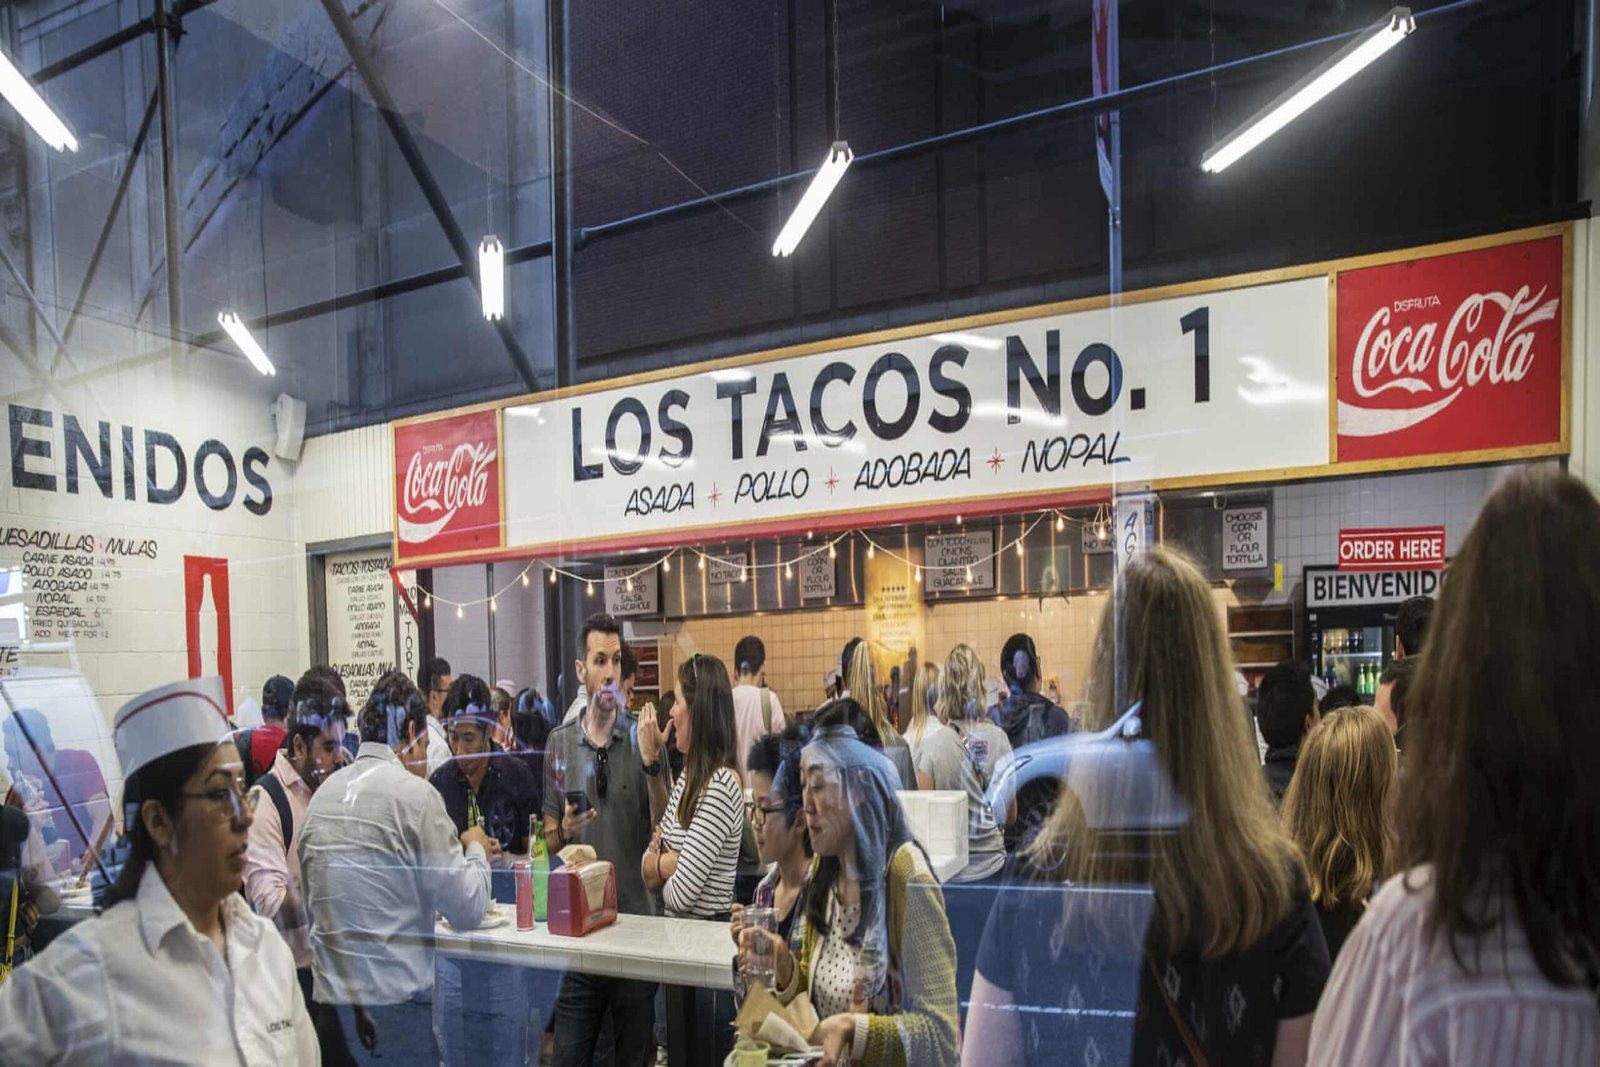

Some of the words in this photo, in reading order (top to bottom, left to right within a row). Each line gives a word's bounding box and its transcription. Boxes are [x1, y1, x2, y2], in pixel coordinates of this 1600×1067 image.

[1394, 295, 1440, 312] DISFRUTA
[572, 389, 693, 481] LOS
[716, 344, 972, 460] TACOS
[1006, 329, 1146, 425] No.
[1180, 306, 1210, 403] 1
[8, 403, 272, 515] ENIDOS
[624, 481, 694, 517] ASADA
[734, 467, 810, 504] POLLO
[854, 447, 971, 491] ADOBADA
[1022, 431, 1132, 473] NOPAL
[1226, 511, 1263, 523] CHOOSE
[1232, 522, 1258, 533] CORN
[1238, 532, 1251, 542] OR
[105, 537, 158, 559] MULAS
[1230, 542, 1259, 553] FLOUR
[1340, 539, 1395, 560] ORDER
[1400, 538, 1442, 559] HERE
[23, 552, 58, 565] CARNE
[61, 554, 94, 566] ASADA
[1226, 553, 1264, 565] TORTILLA
[23, 564, 54, 577] POLLO
[58, 567, 92, 579] ASADO
[332, 560, 359, 576] TACOS
[32, 579, 87, 591] ADOBADA
[36, 592, 74, 604] NOPAL
[35, 606, 86, 618] ESPECIAL
